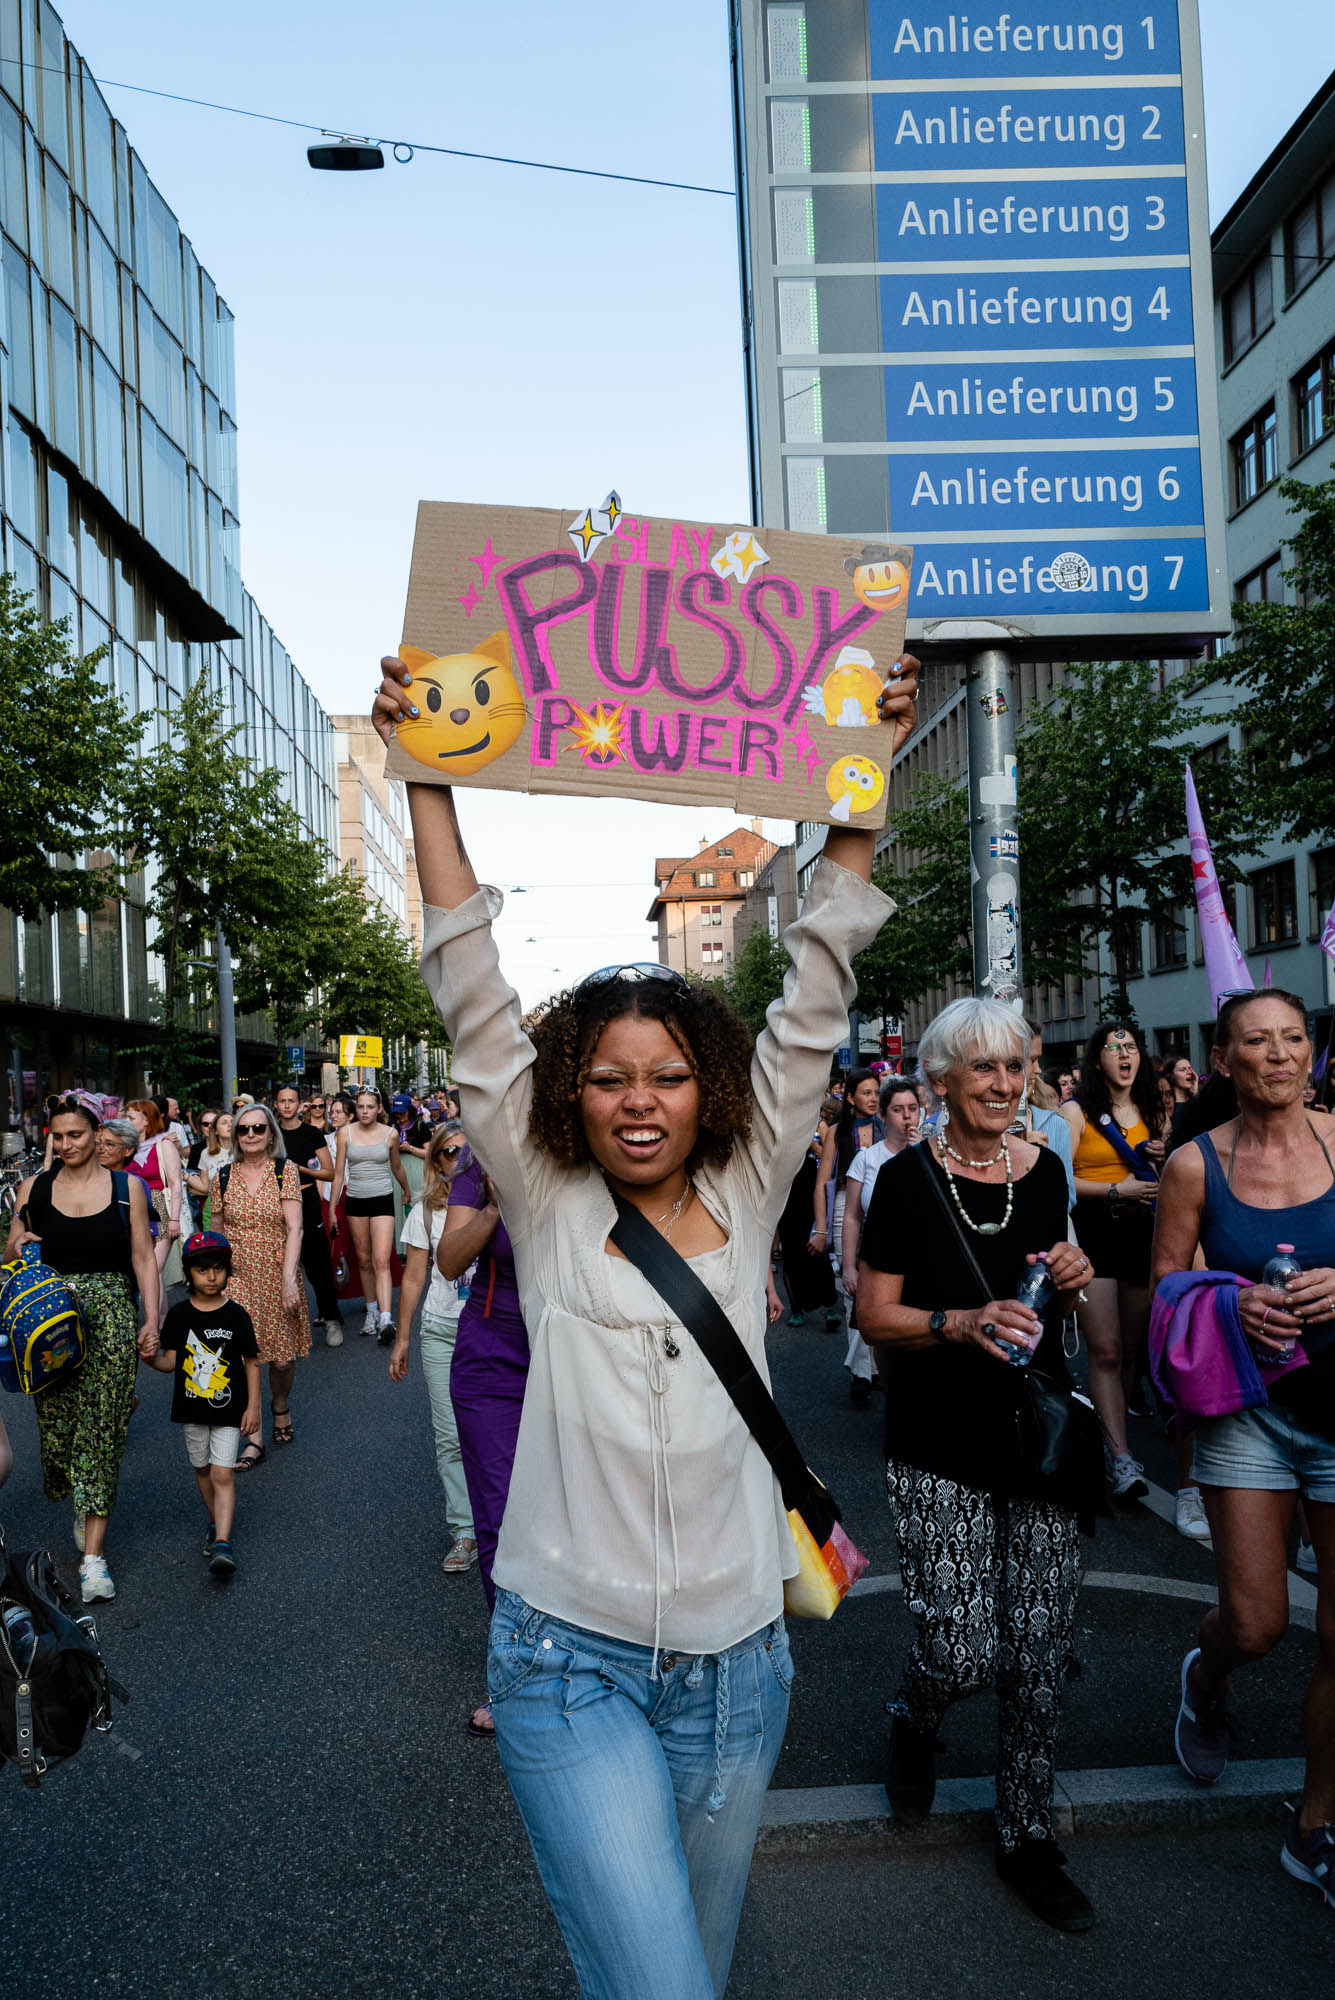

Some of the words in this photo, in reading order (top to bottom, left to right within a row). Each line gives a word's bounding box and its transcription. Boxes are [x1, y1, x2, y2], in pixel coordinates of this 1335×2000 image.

[893, 15, 1124, 60] Anlieferung
[1141, 17, 1155, 49] 1
[894, 105, 1126, 150] Anlieferung
[1142, 106, 1162, 139] 2
[898, 196, 1129, 241] Anlieferung
[1145, 196, 1166, 230] 3
[901, 287, 1132, 331] Anlieferung
[1148, 287, 1170, 320] 4
[906, 377, 1138, 422] Anlieferung
[1154, 377, 1175, 410] 5
[911, 467, 1142, 511] Anlieferung
[1158, 466, 1180, 500] 6
[610, 518, 714, 569] SLAY
[916, 558, 1148, 601] Anliefeung
[1165, 556, 1184, 589] 7
[495, 548, 882, 729] PUSSY
[292, 1048, 299, 1058] P
